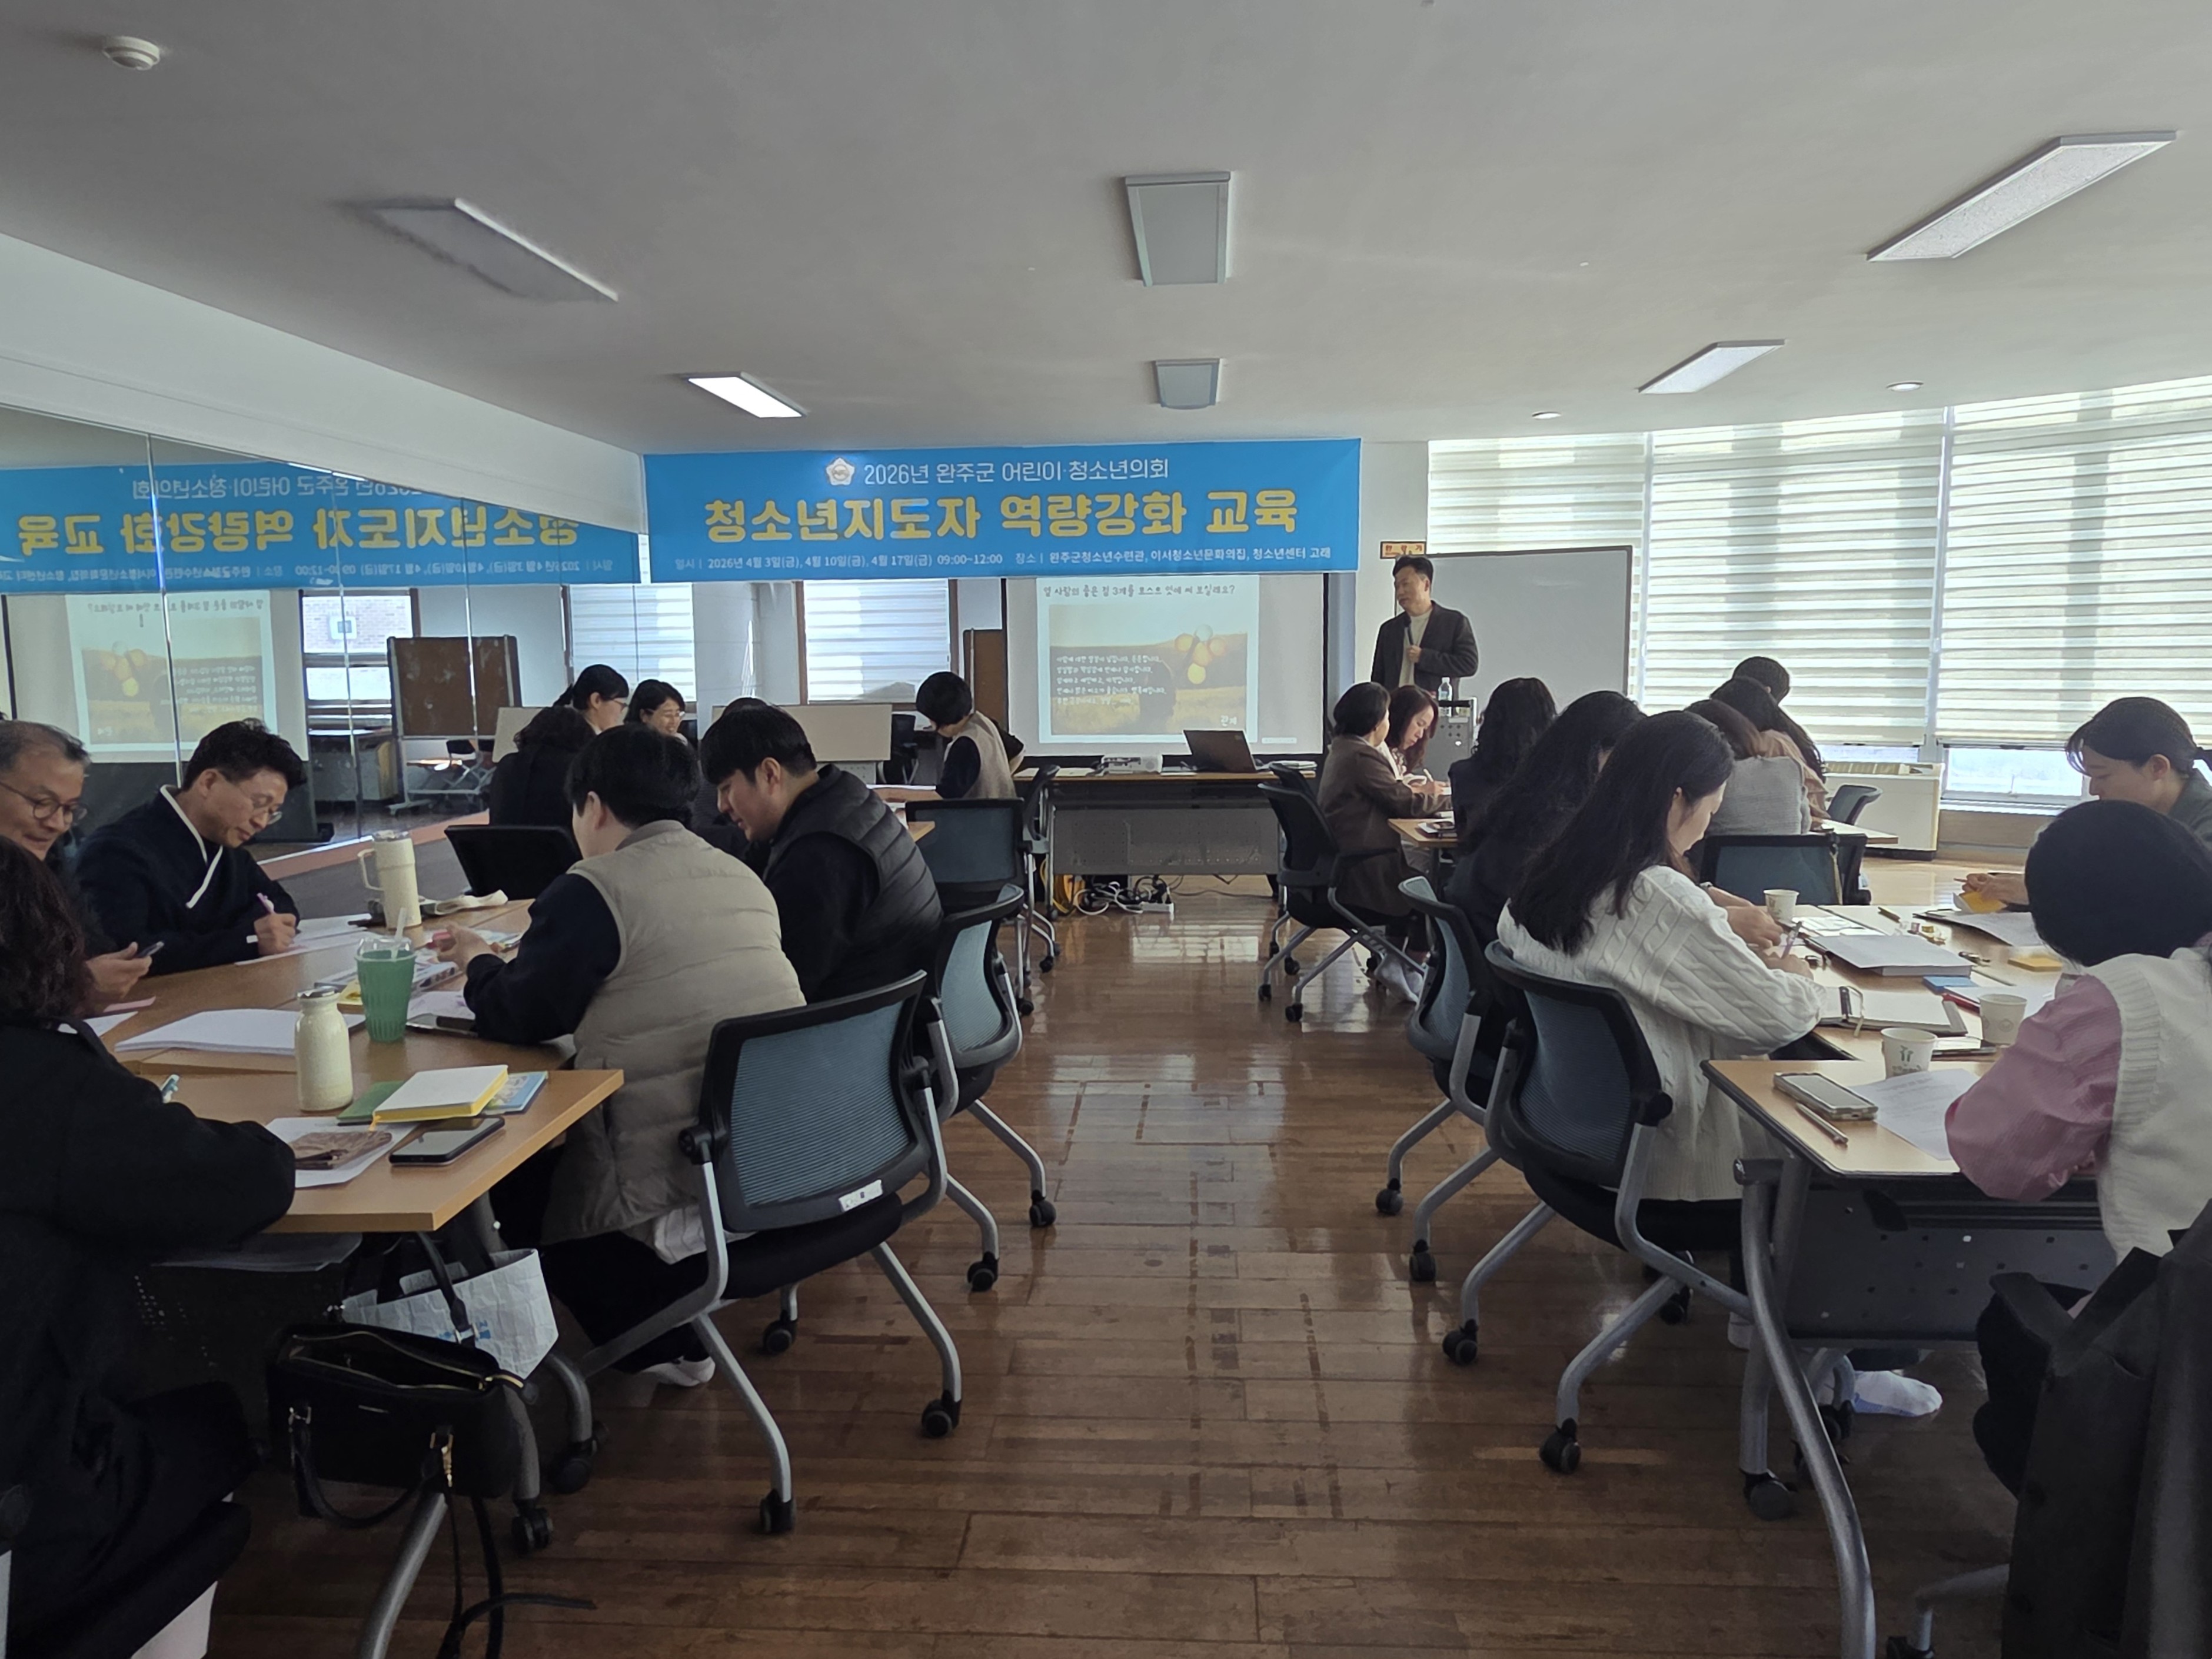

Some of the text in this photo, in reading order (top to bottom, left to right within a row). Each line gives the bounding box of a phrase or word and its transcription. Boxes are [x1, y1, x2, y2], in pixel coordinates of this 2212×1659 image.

[864, 464, 929, 484] 2026년
[936, 463, 994, 483] 완주군
[705, 489, 1297, 543] 청소년지도자 역량강화 교육
[708, 557, 743, 568] 2026년
[746, 557, 762, 568] 4월
[805, 556, 821, 567] 4월
[871, 555, 887, 567] 4월
[892, 554, 932, 567] 17일(금)
[937, 554, 1003, 565] 09:00~12:00
[1016, 553, 1036, 564] 장소
[1253, 547, 1306, 560] 청소년센터
[1310, 547, 1331, 558] 고래
